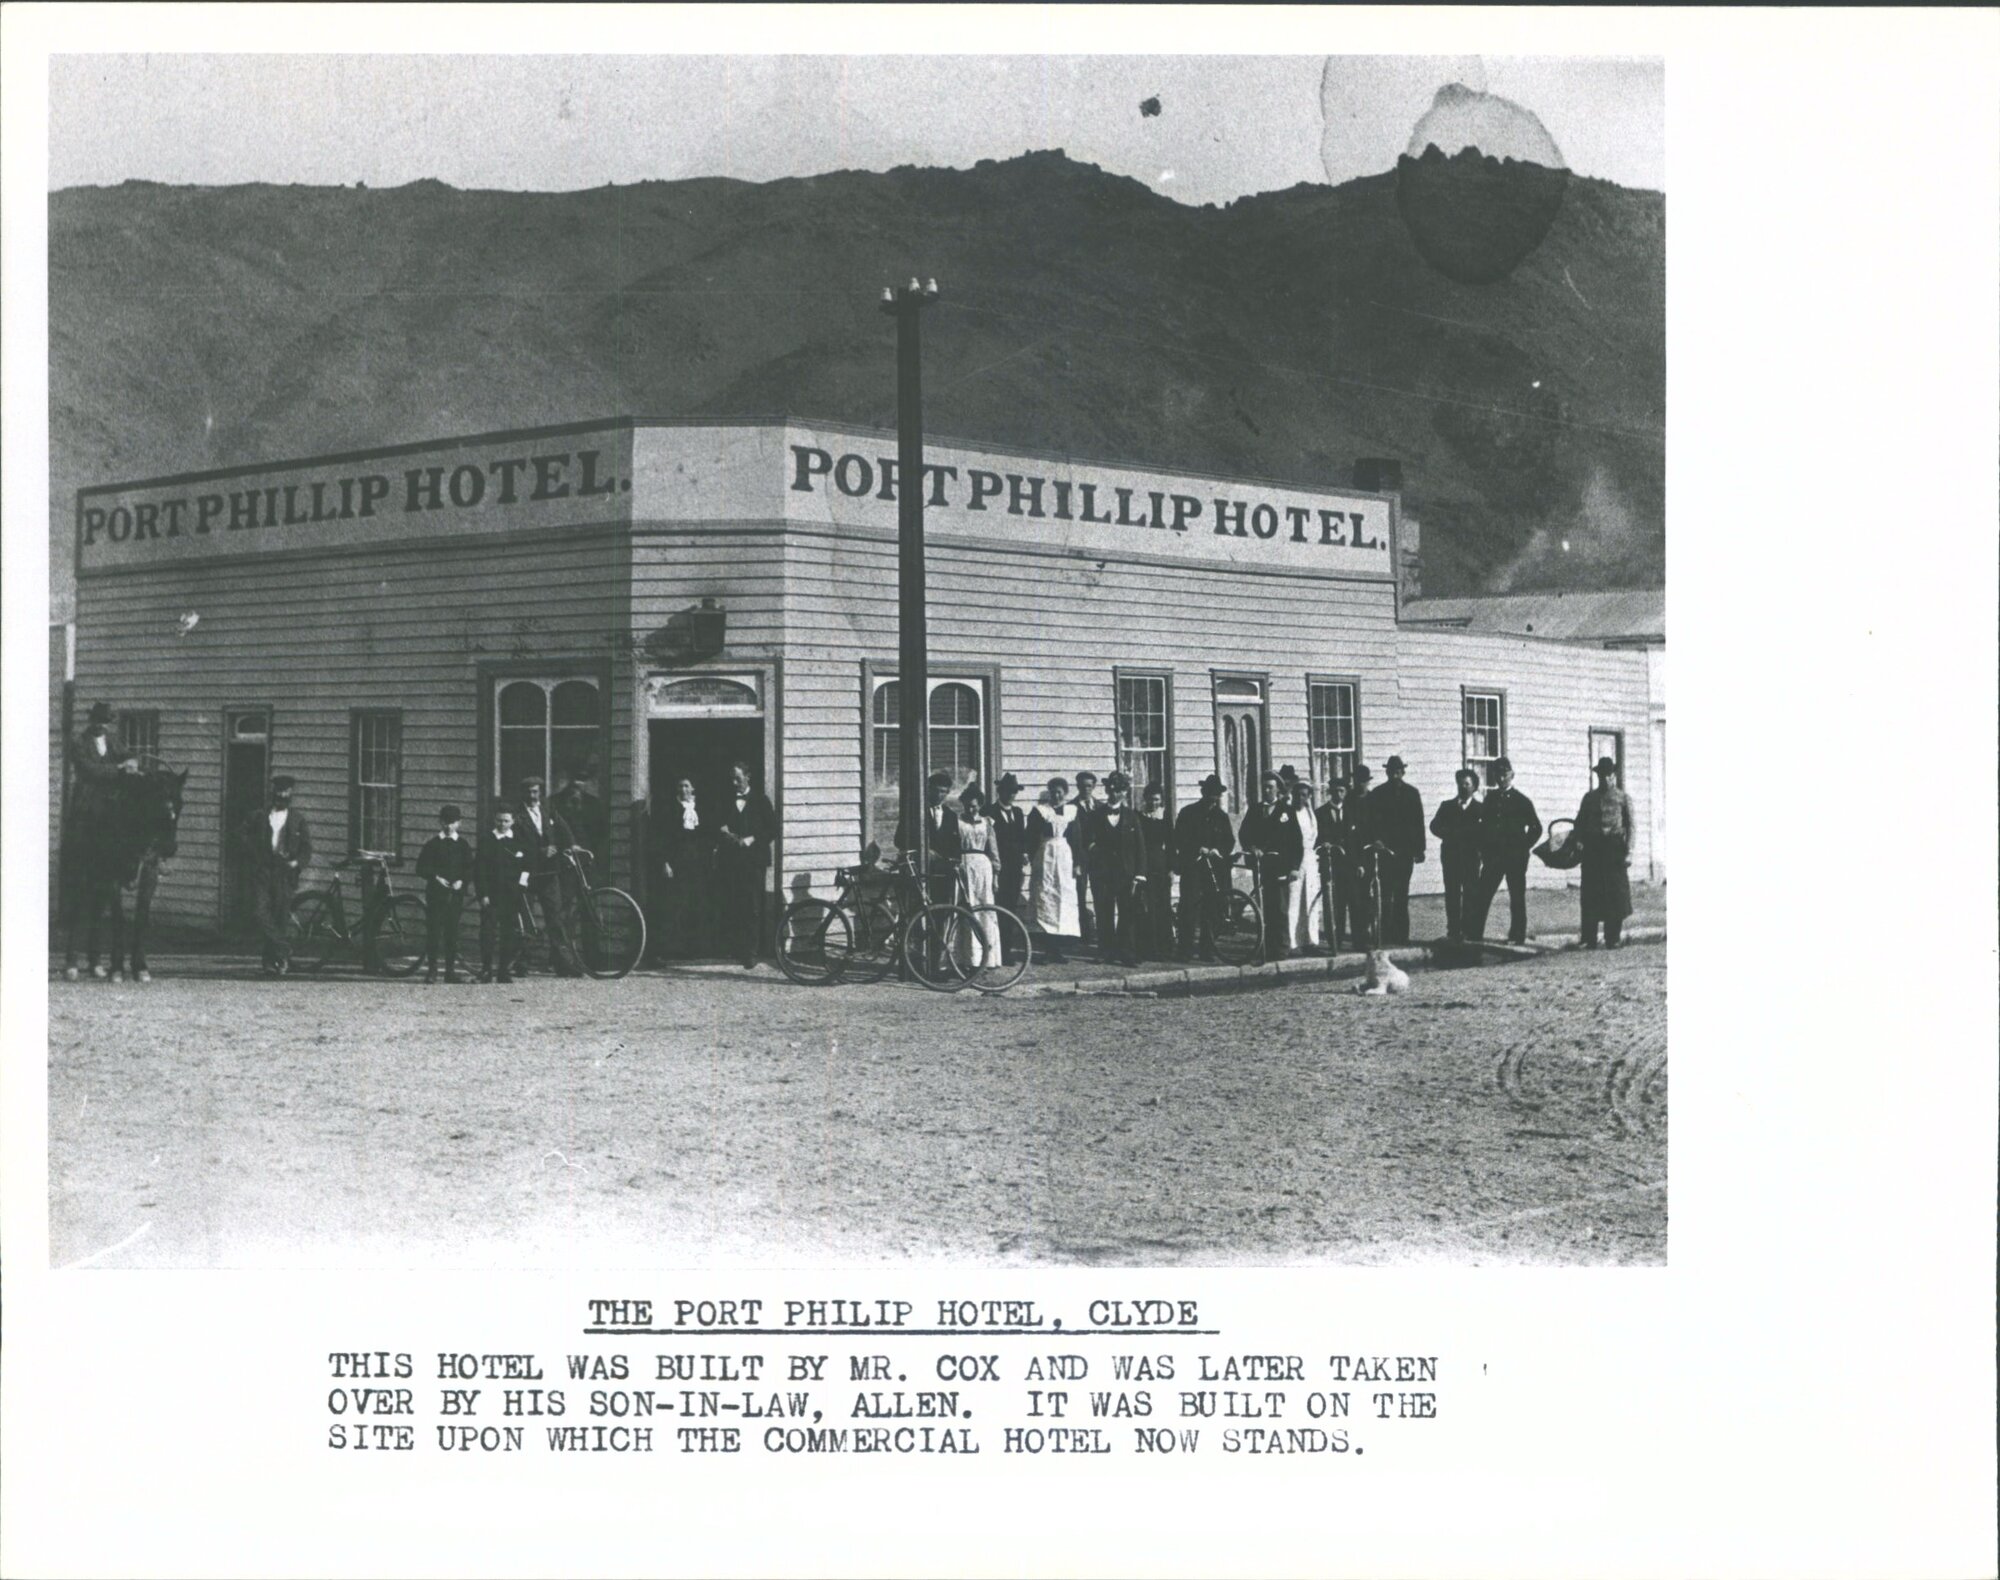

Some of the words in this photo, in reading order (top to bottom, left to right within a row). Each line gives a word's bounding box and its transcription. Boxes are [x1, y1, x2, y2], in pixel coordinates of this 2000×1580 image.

[83, 499, 187, 546] PORT
[195, 474, 390, 534] PHILLIP
[403, 451, 632, 513] HOTEL.
[967, 469, 1202, 532] PHILLIP
[1213, 498, 1387, 551] HOTEL.
